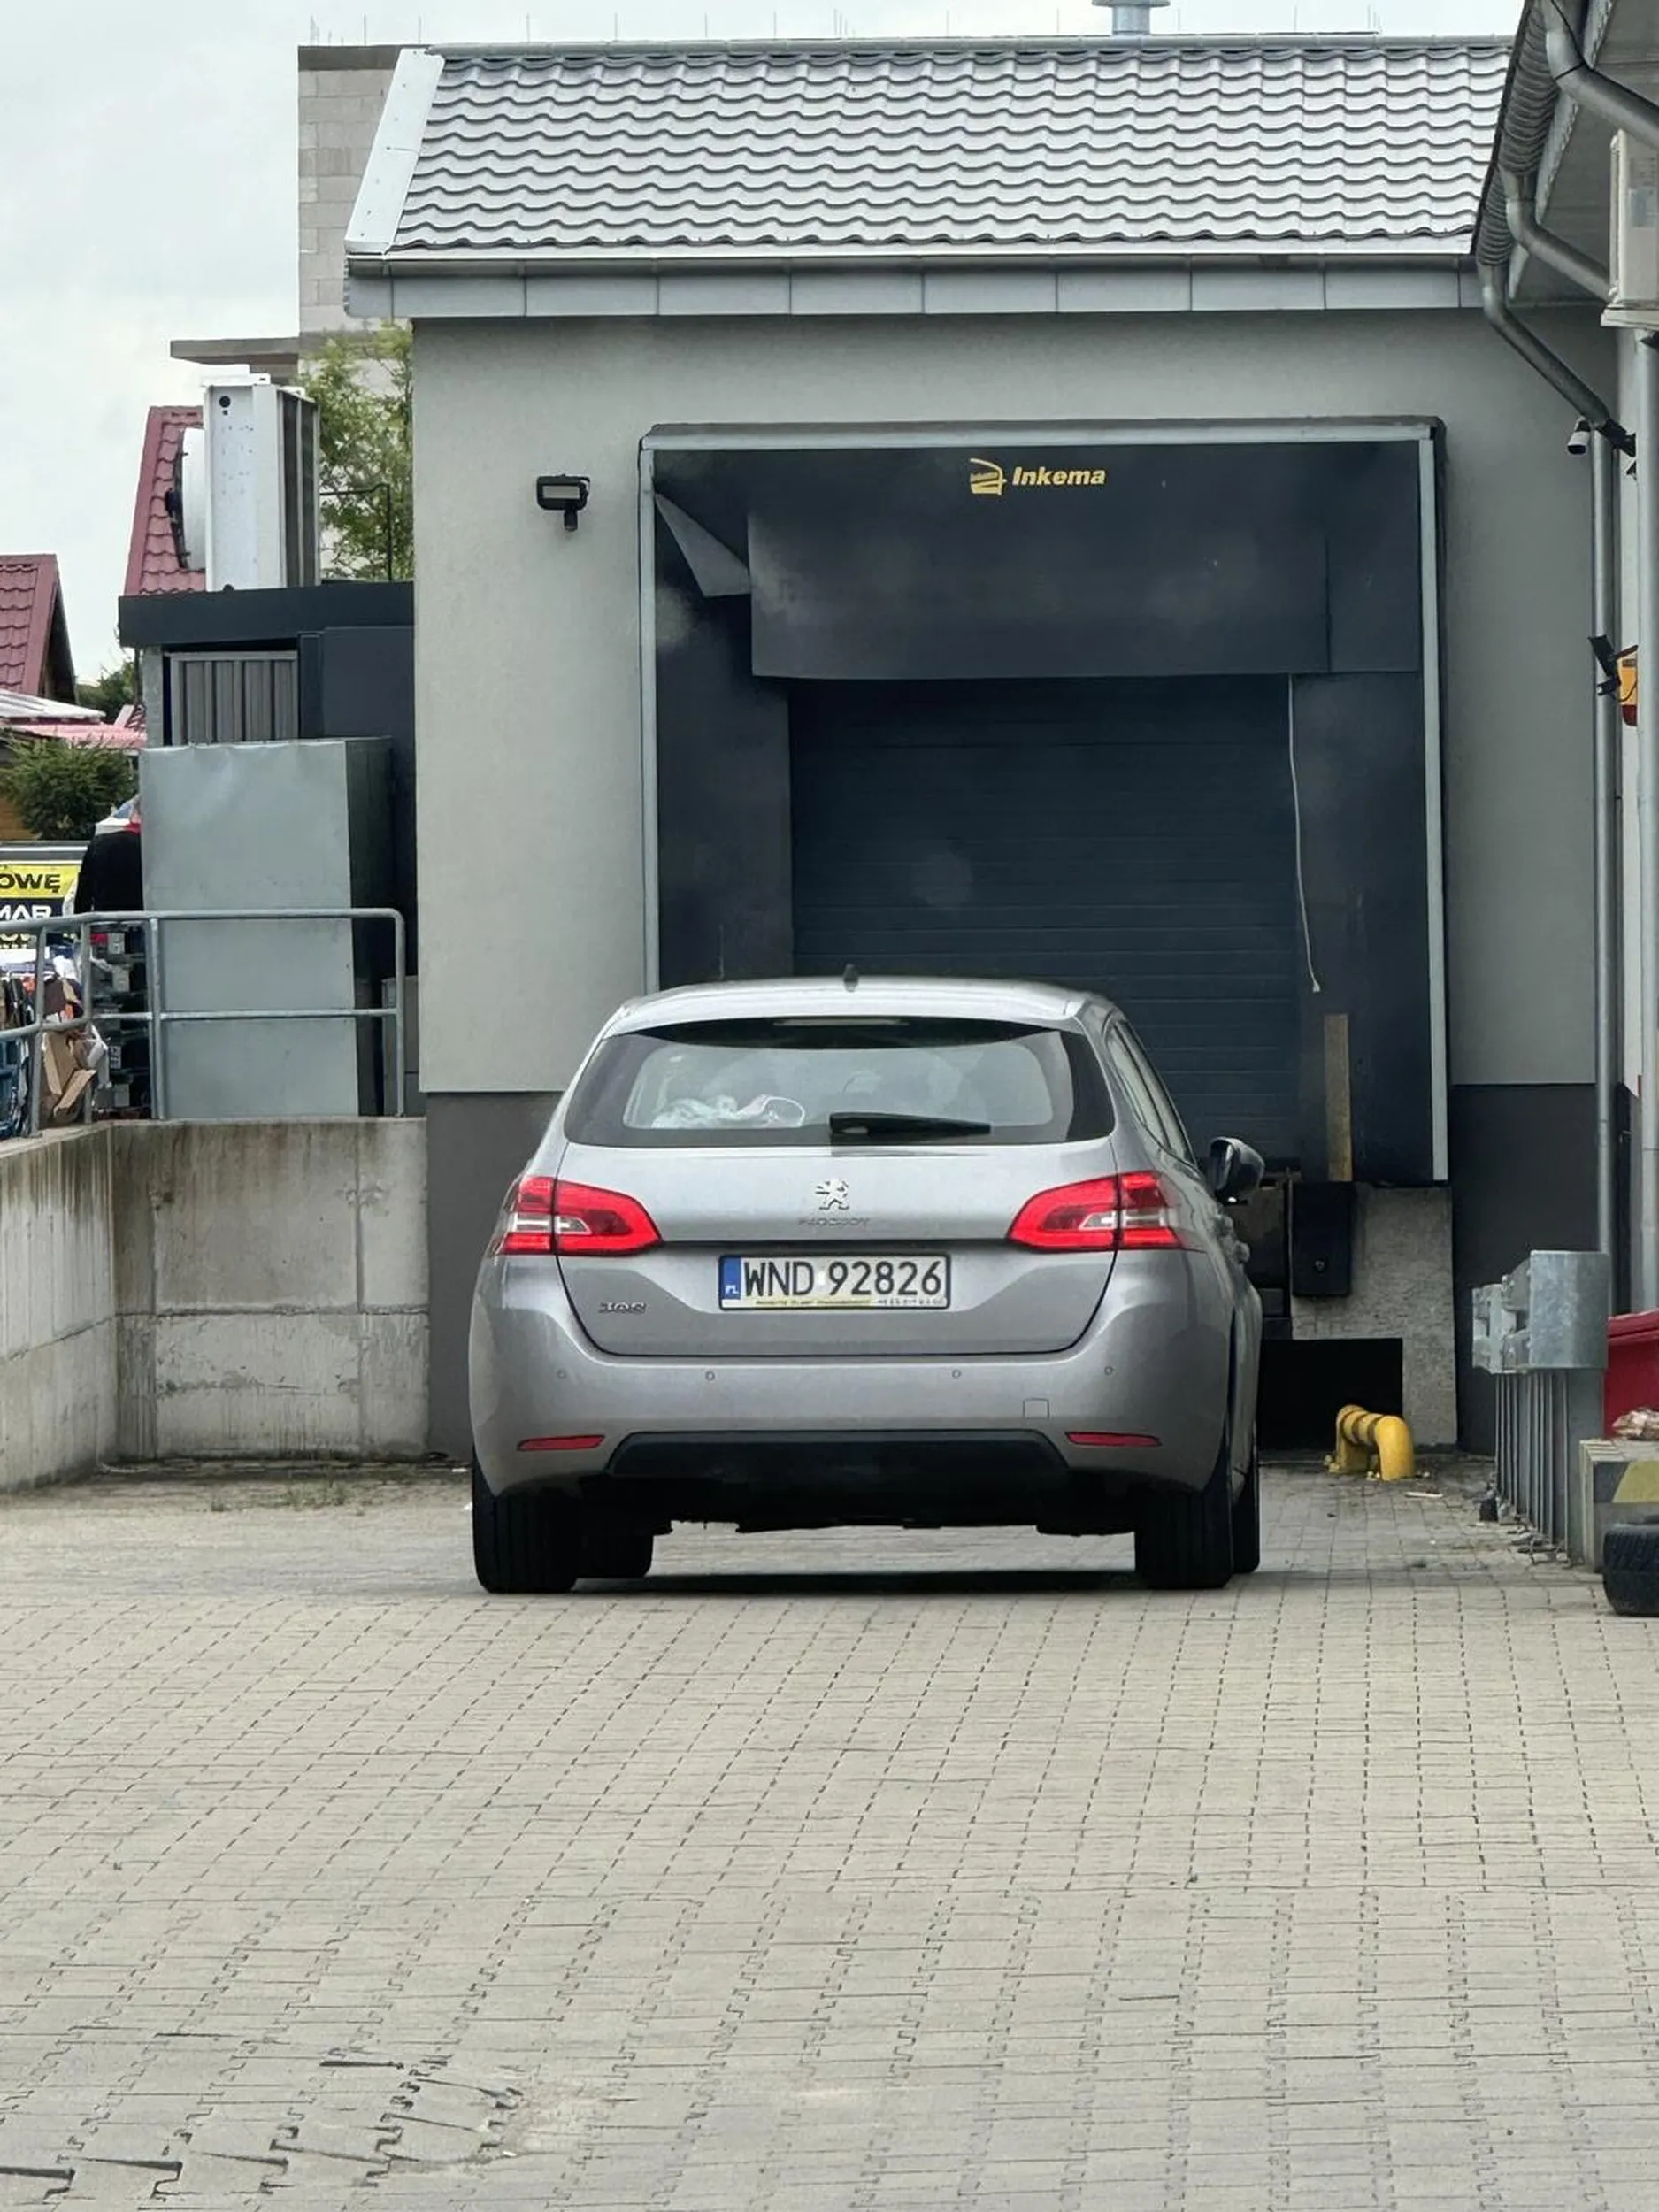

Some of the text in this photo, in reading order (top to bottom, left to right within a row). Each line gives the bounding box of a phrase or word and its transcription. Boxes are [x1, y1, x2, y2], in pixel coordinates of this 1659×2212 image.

[1012, 466, 1106, 486] Inkema
[744, 1261, 942, 1297] WND 92826
